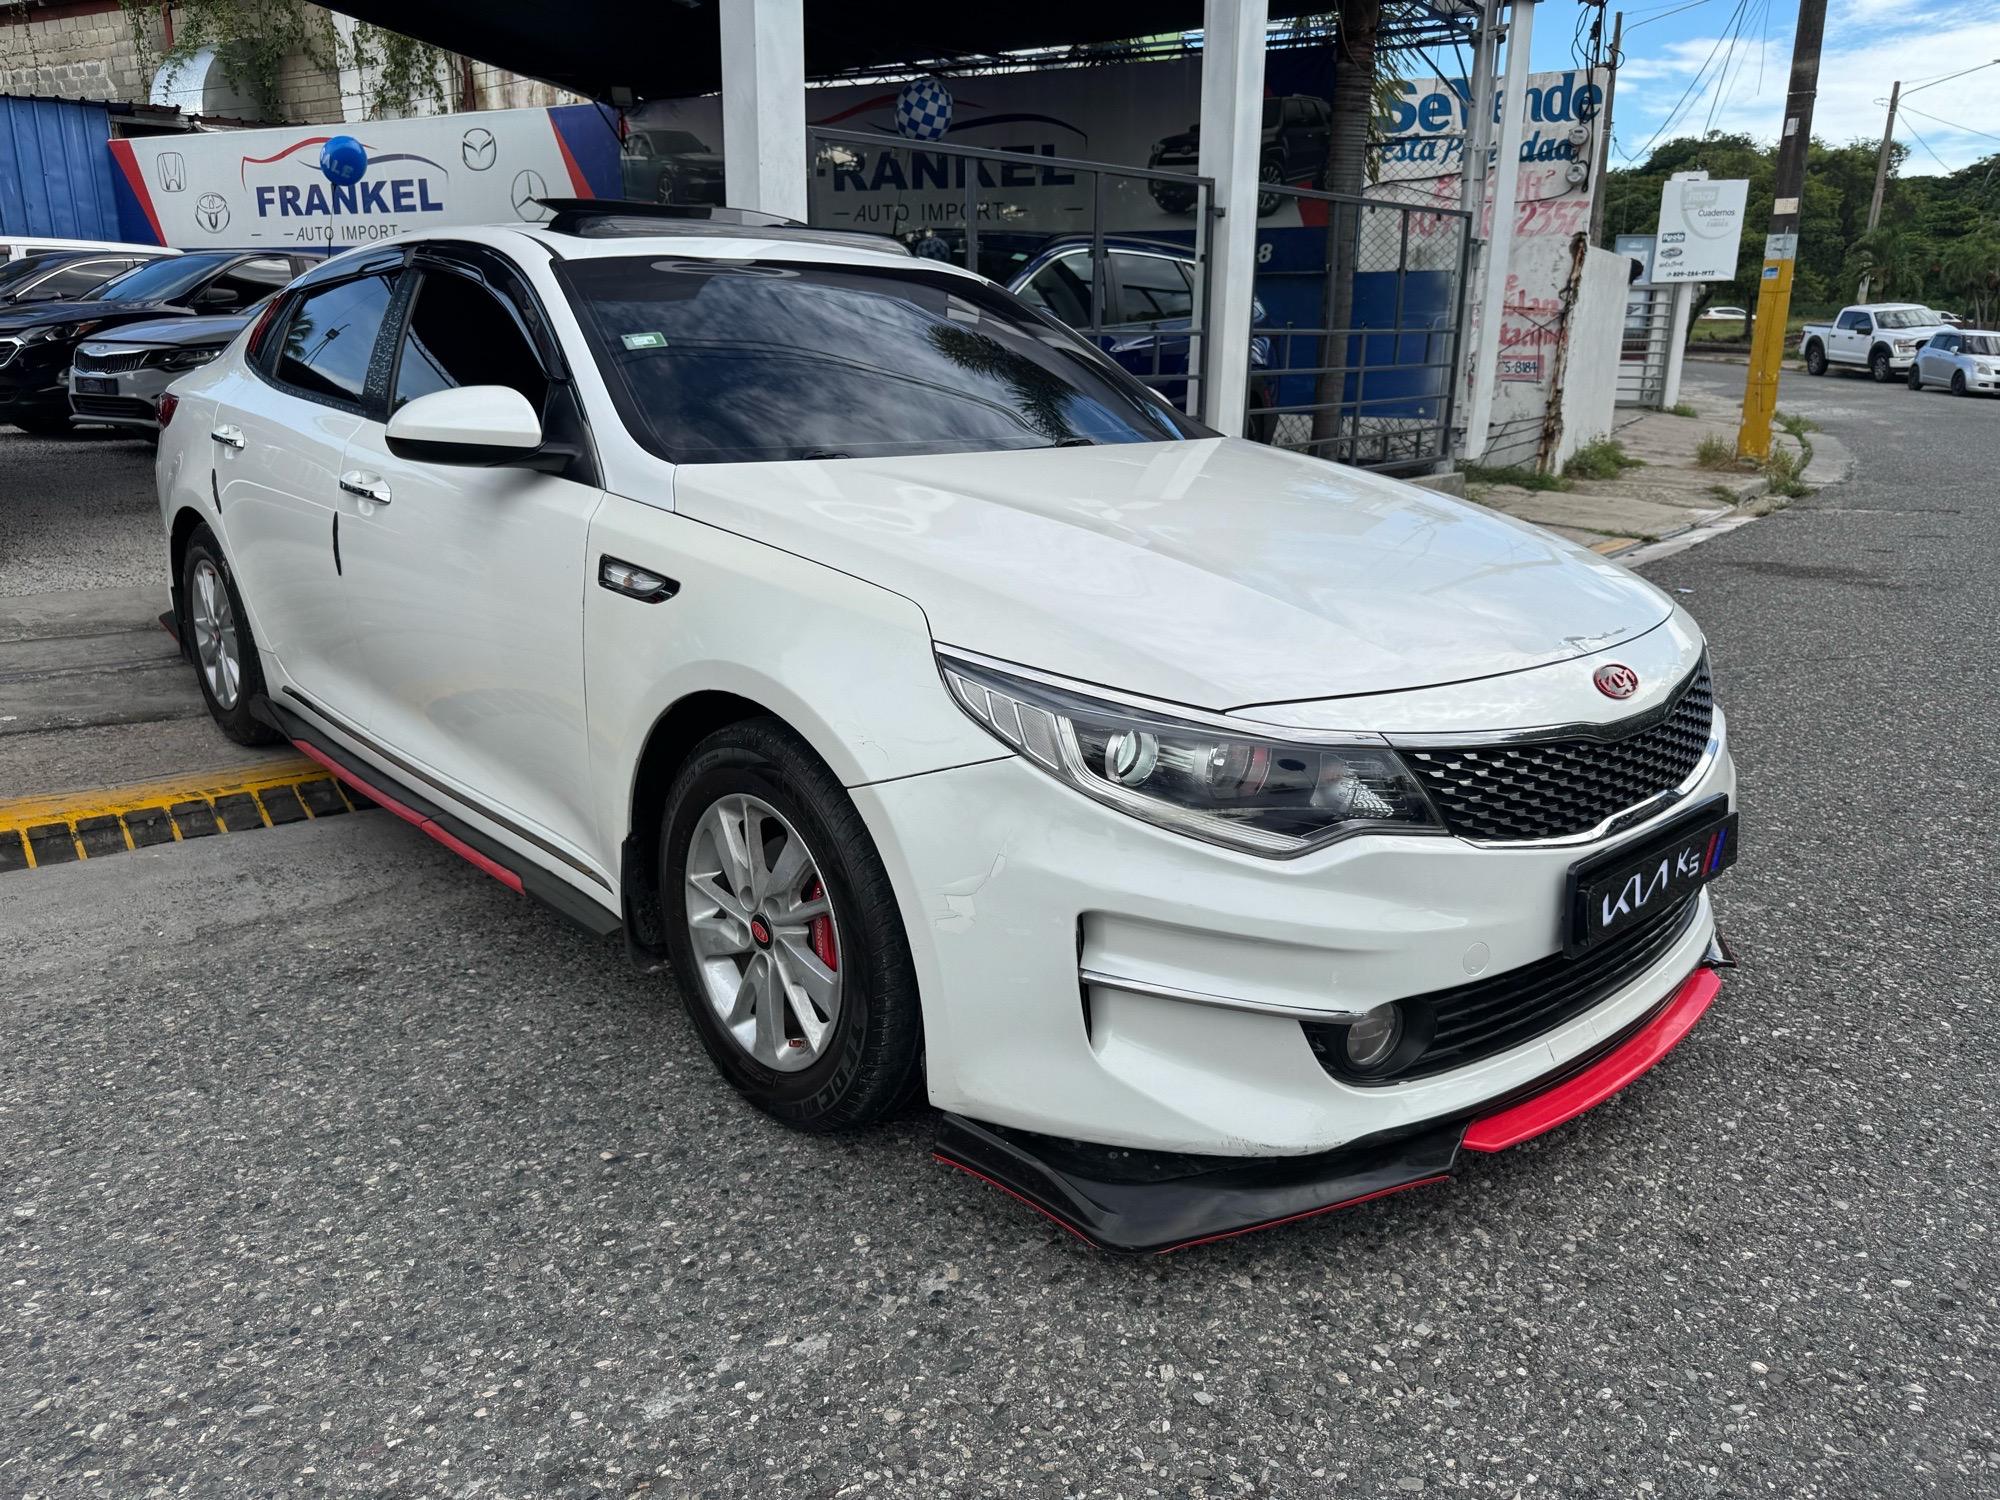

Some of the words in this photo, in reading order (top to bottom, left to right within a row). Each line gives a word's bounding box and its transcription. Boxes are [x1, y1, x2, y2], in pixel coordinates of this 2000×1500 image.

[320, 148, 354, 179] ALE
[816, 144, 1076, 192] RANKEL
[256, 178, 443, 218] FRANKEL
[853, 203, 910, 223] AUTO
[296, 226, 335, 242] AUTO
[342, 224, 399, 241] IMPORT
